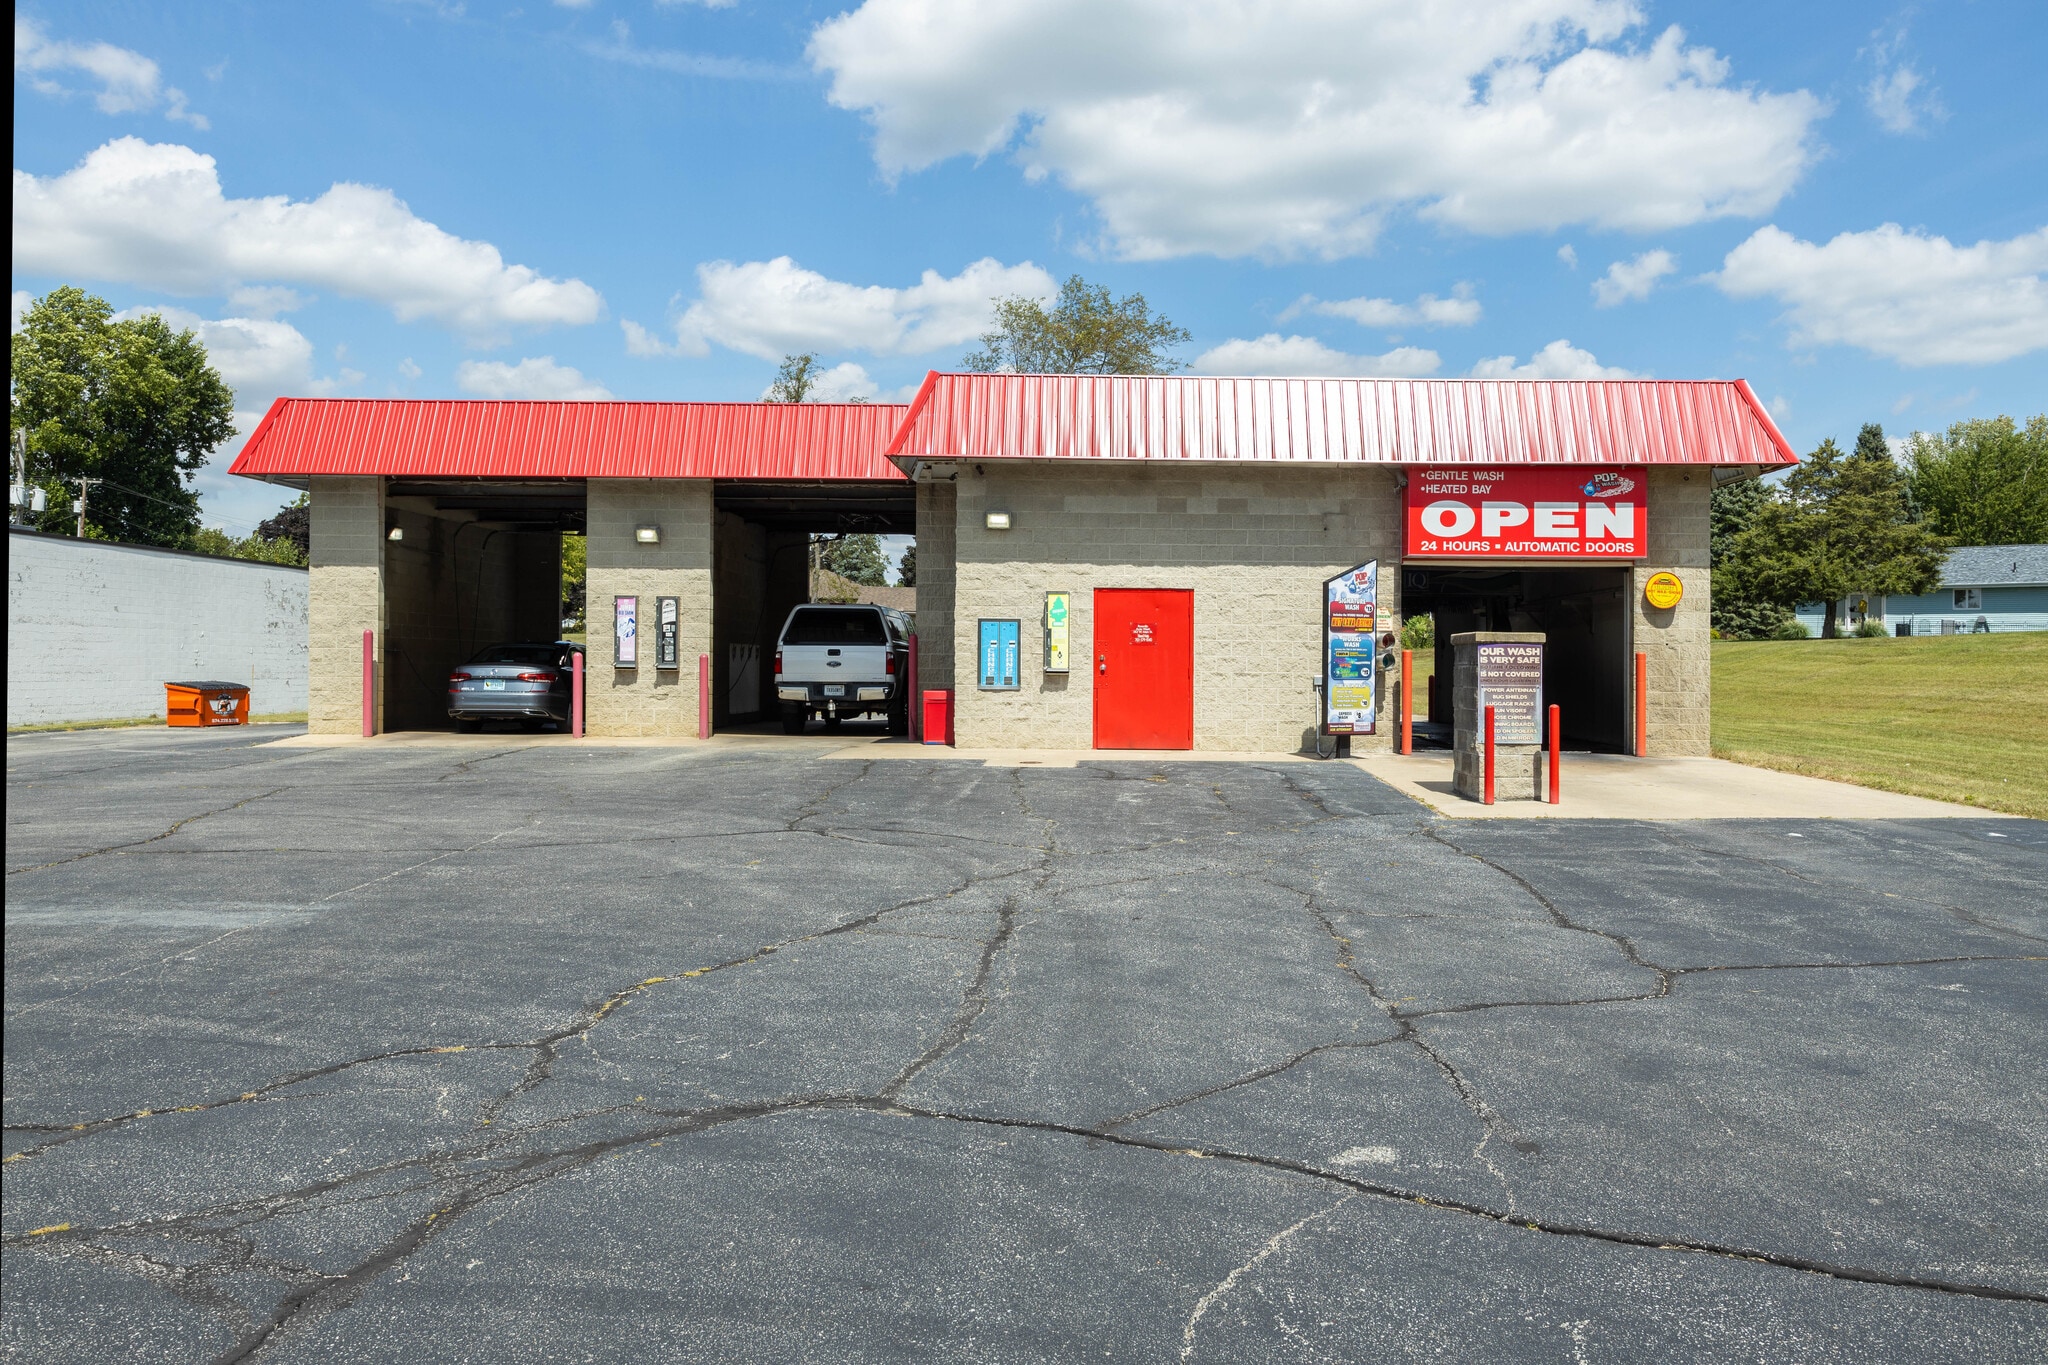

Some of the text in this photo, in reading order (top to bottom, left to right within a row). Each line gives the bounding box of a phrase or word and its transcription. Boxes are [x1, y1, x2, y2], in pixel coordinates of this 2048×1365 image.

[1426, 470, 1504, 480] GENTLE WASH
[1594, 473, 1618, 482] POP
[1426, 484, 1492, 494] HEATED BAY
[1421, 500, 1634, 538] OPEN
[1421, 541, 1634, 552] 24 HOURS AUTOMATIC DOORS
[1355, 572, 1367, 581] POP
[1480, 647, 1504, 655] OUR
